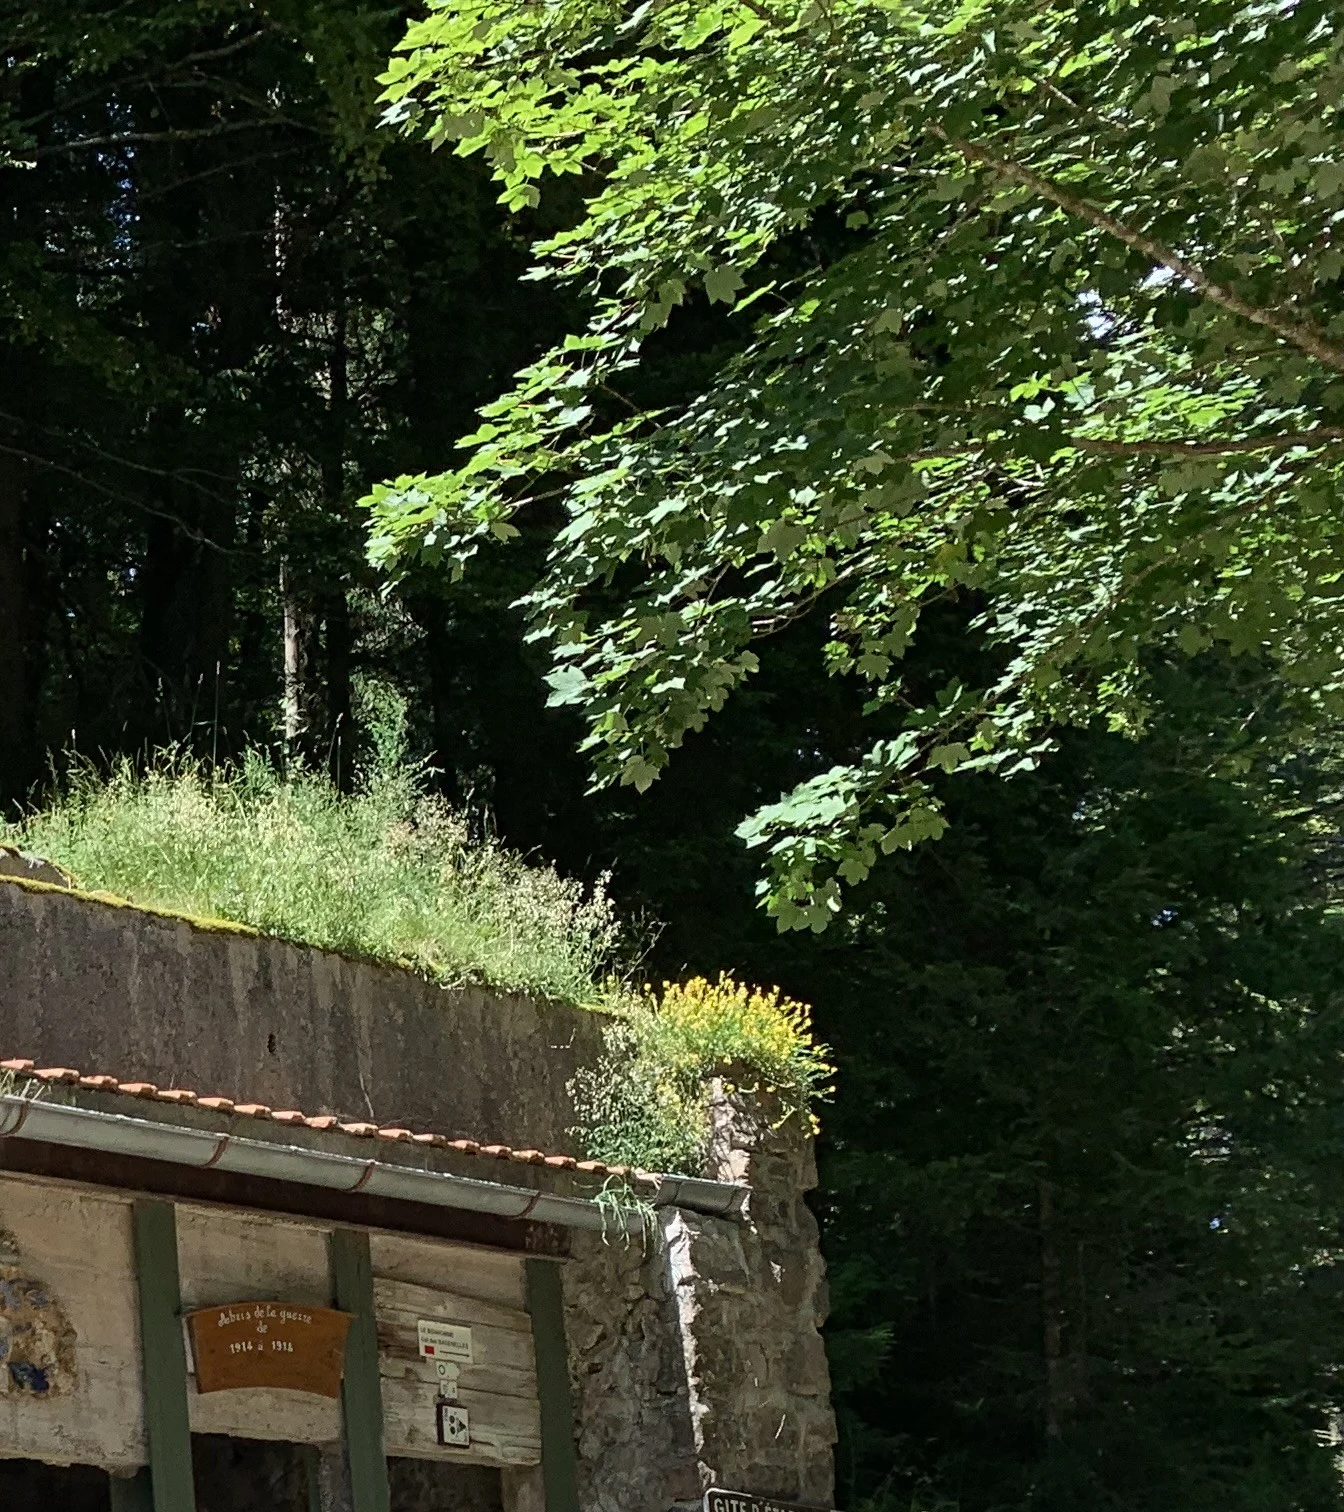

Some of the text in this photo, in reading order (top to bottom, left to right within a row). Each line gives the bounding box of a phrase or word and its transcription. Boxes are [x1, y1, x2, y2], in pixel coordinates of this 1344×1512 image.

[279, 1310, 312, 1324] guerre
[256, 1320, 268, 1333] de
[229, 1340, 253, 1354] 1914
